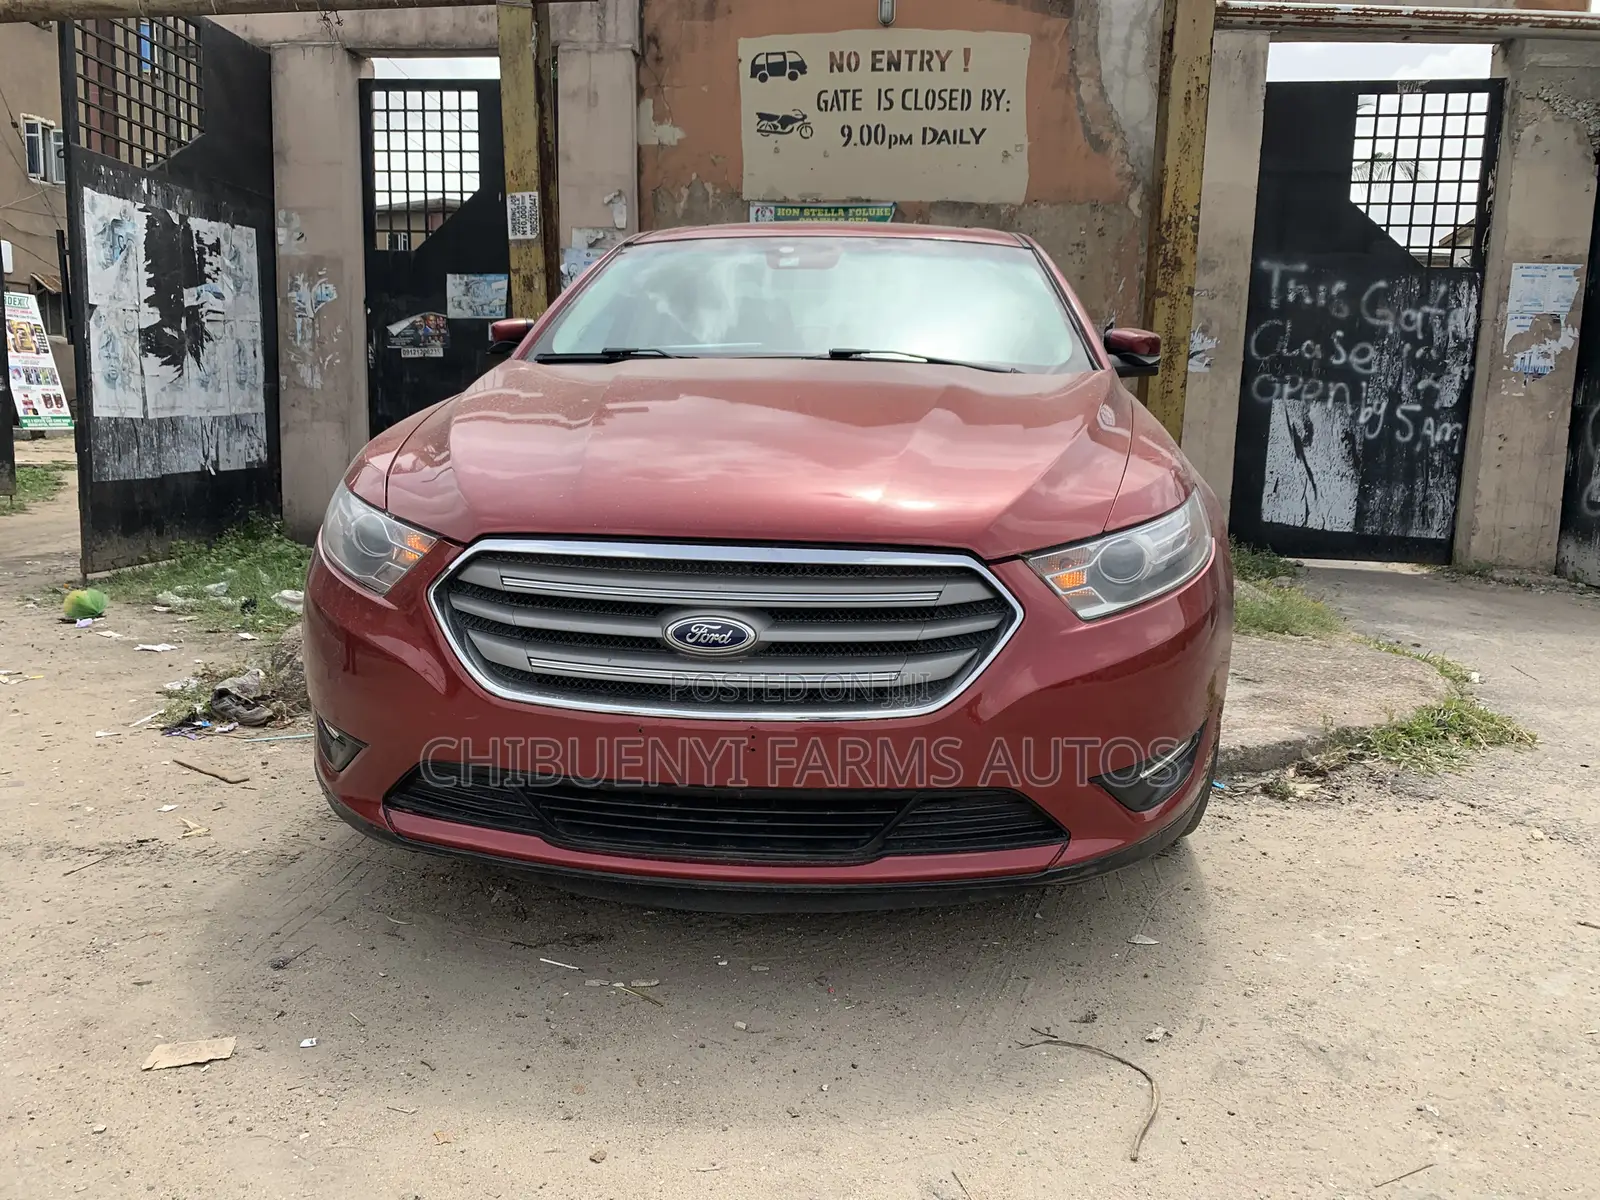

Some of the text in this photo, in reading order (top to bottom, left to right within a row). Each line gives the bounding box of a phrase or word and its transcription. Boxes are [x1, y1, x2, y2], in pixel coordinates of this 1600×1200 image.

[829, 50, 860, 73] NO
[870, 49, 953, 73] ENTRY
[816, 88, 1011, 112] GATE IS CLOSED BY:
[921, 127, 987, 145] DAILY
[776, 207, 800, 217] HON
[804, 207, 844, 217] STELLA
[1260, 259, 1351, 319] This
[1359, 381, 1388, 439] by
[686, 623, 733, 645] Ford
